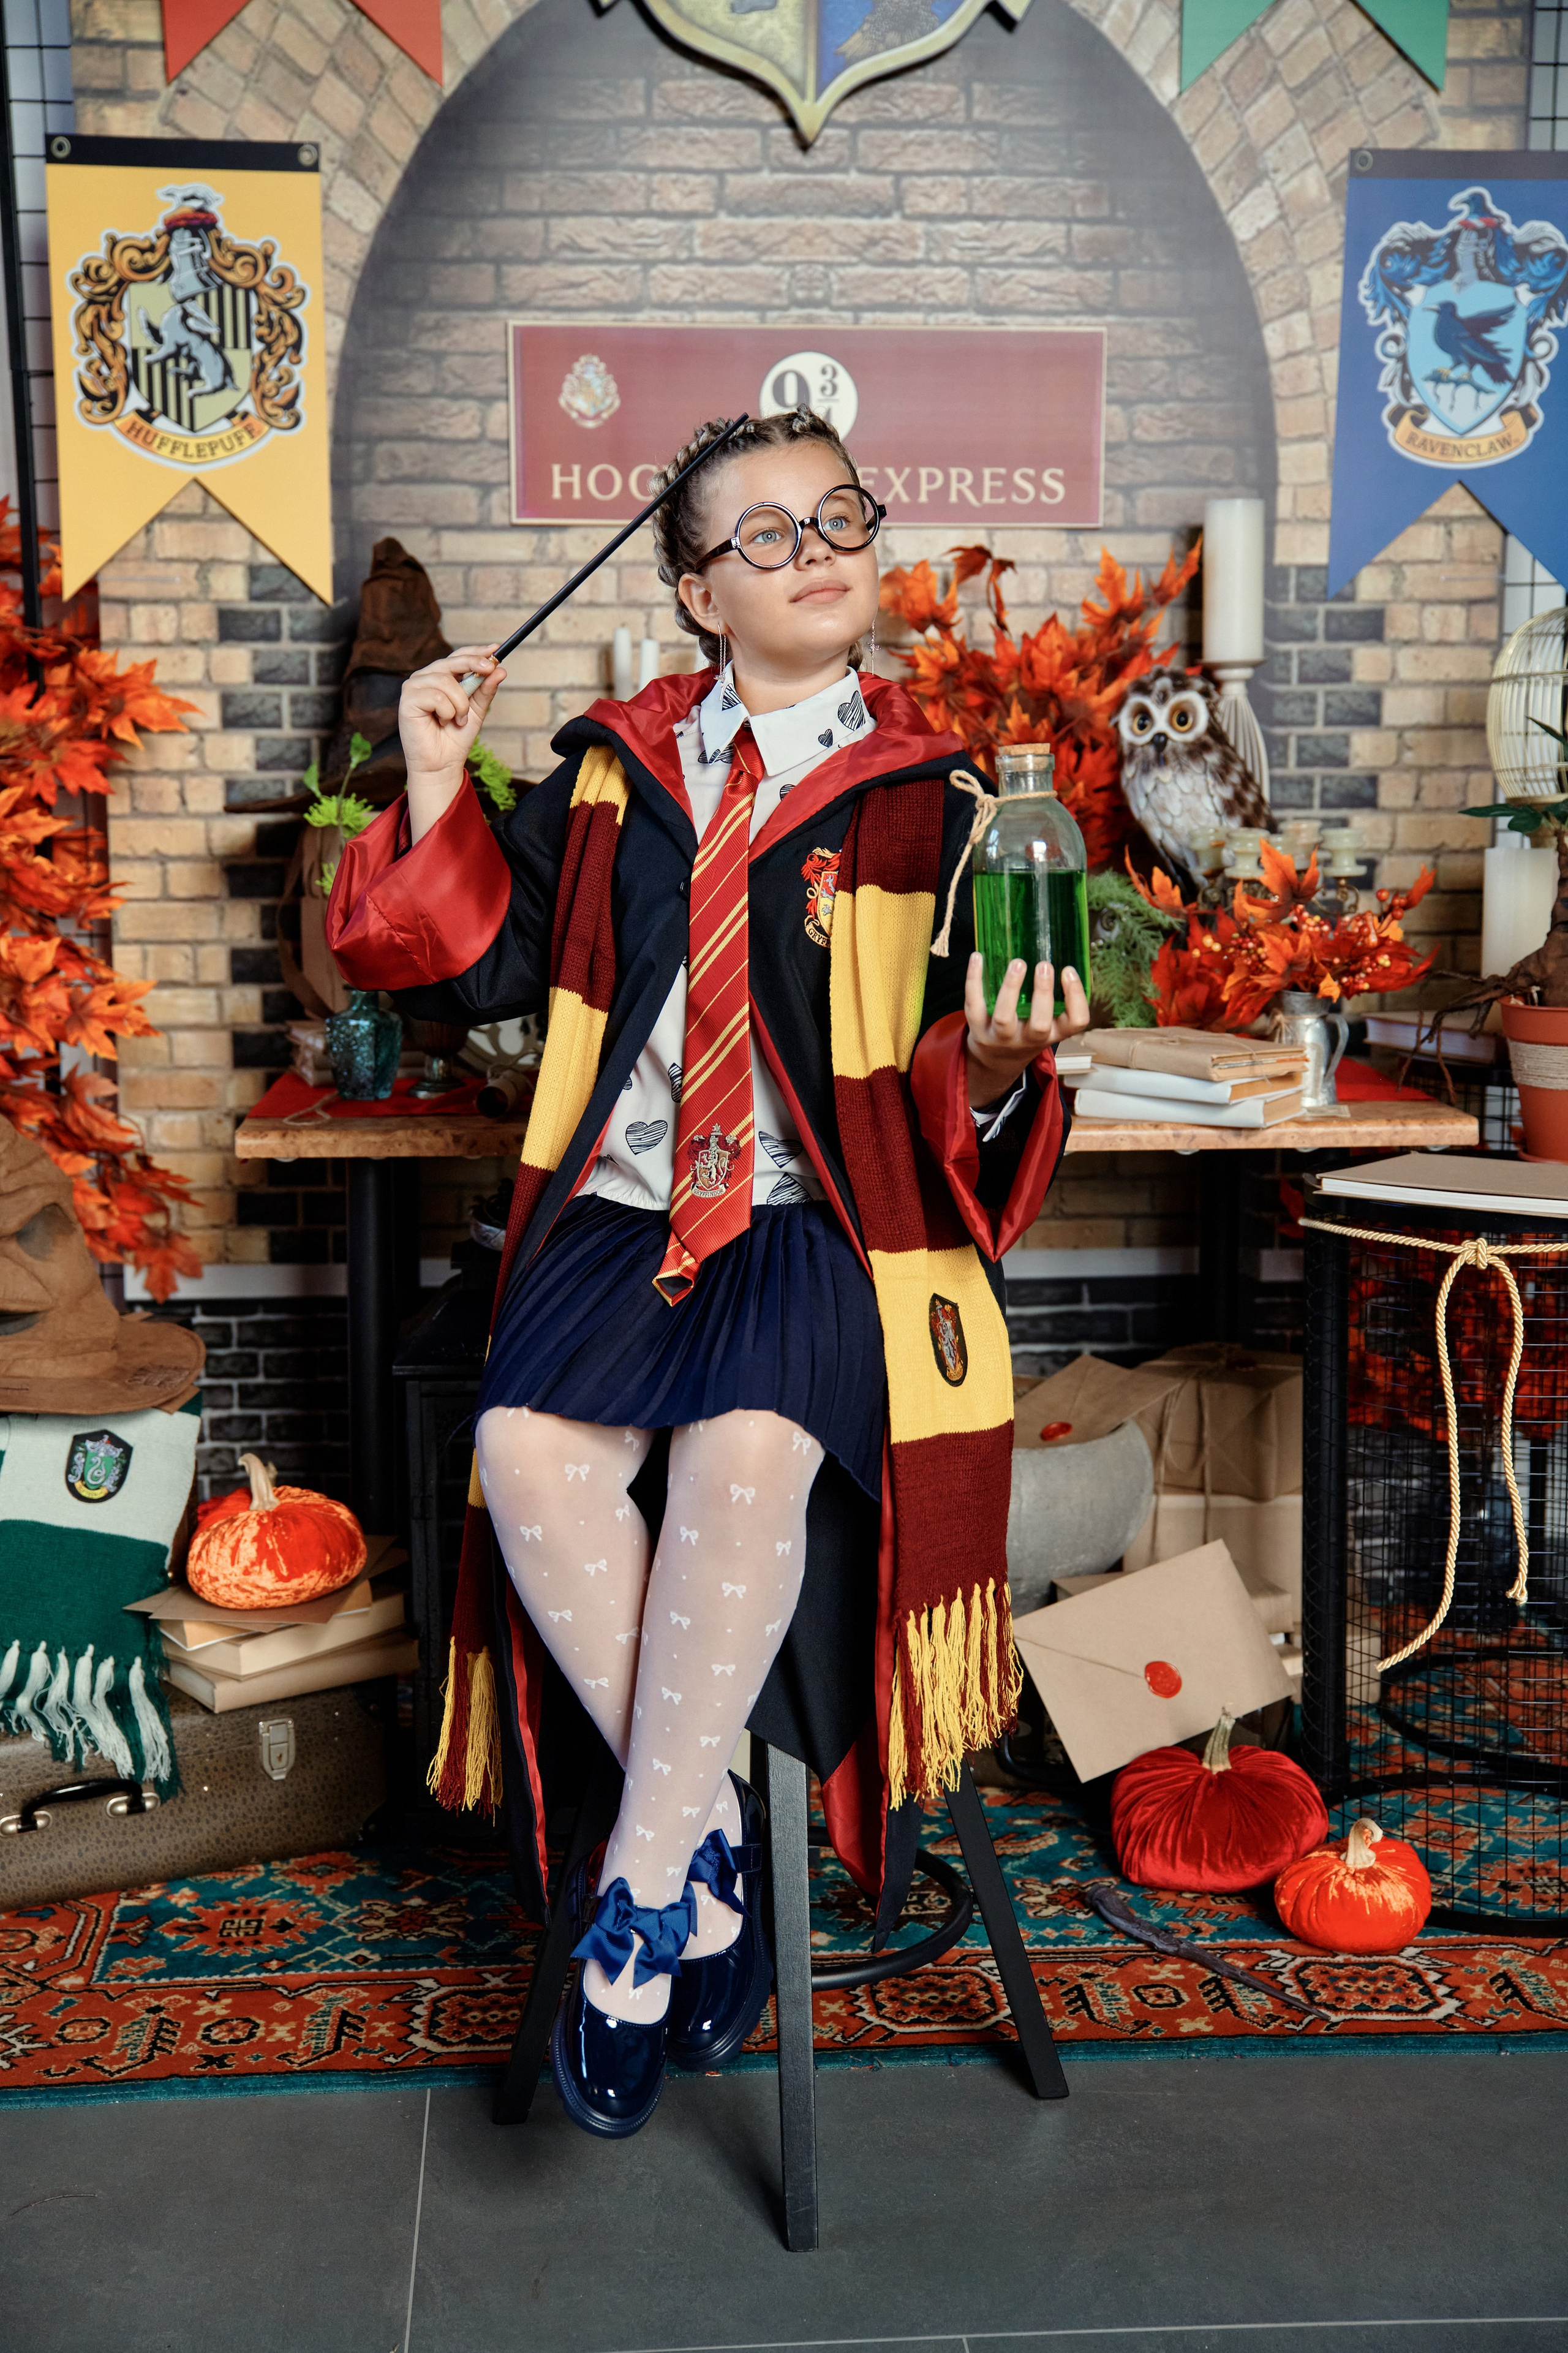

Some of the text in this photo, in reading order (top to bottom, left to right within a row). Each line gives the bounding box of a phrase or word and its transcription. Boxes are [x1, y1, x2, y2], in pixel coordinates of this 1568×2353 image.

[126, 421, 255, 458] HUFFLEPUFF
[1406, 431, 1512, 457] RAVENCLAW
[857, 467, 1066, 508] EXPRESS
